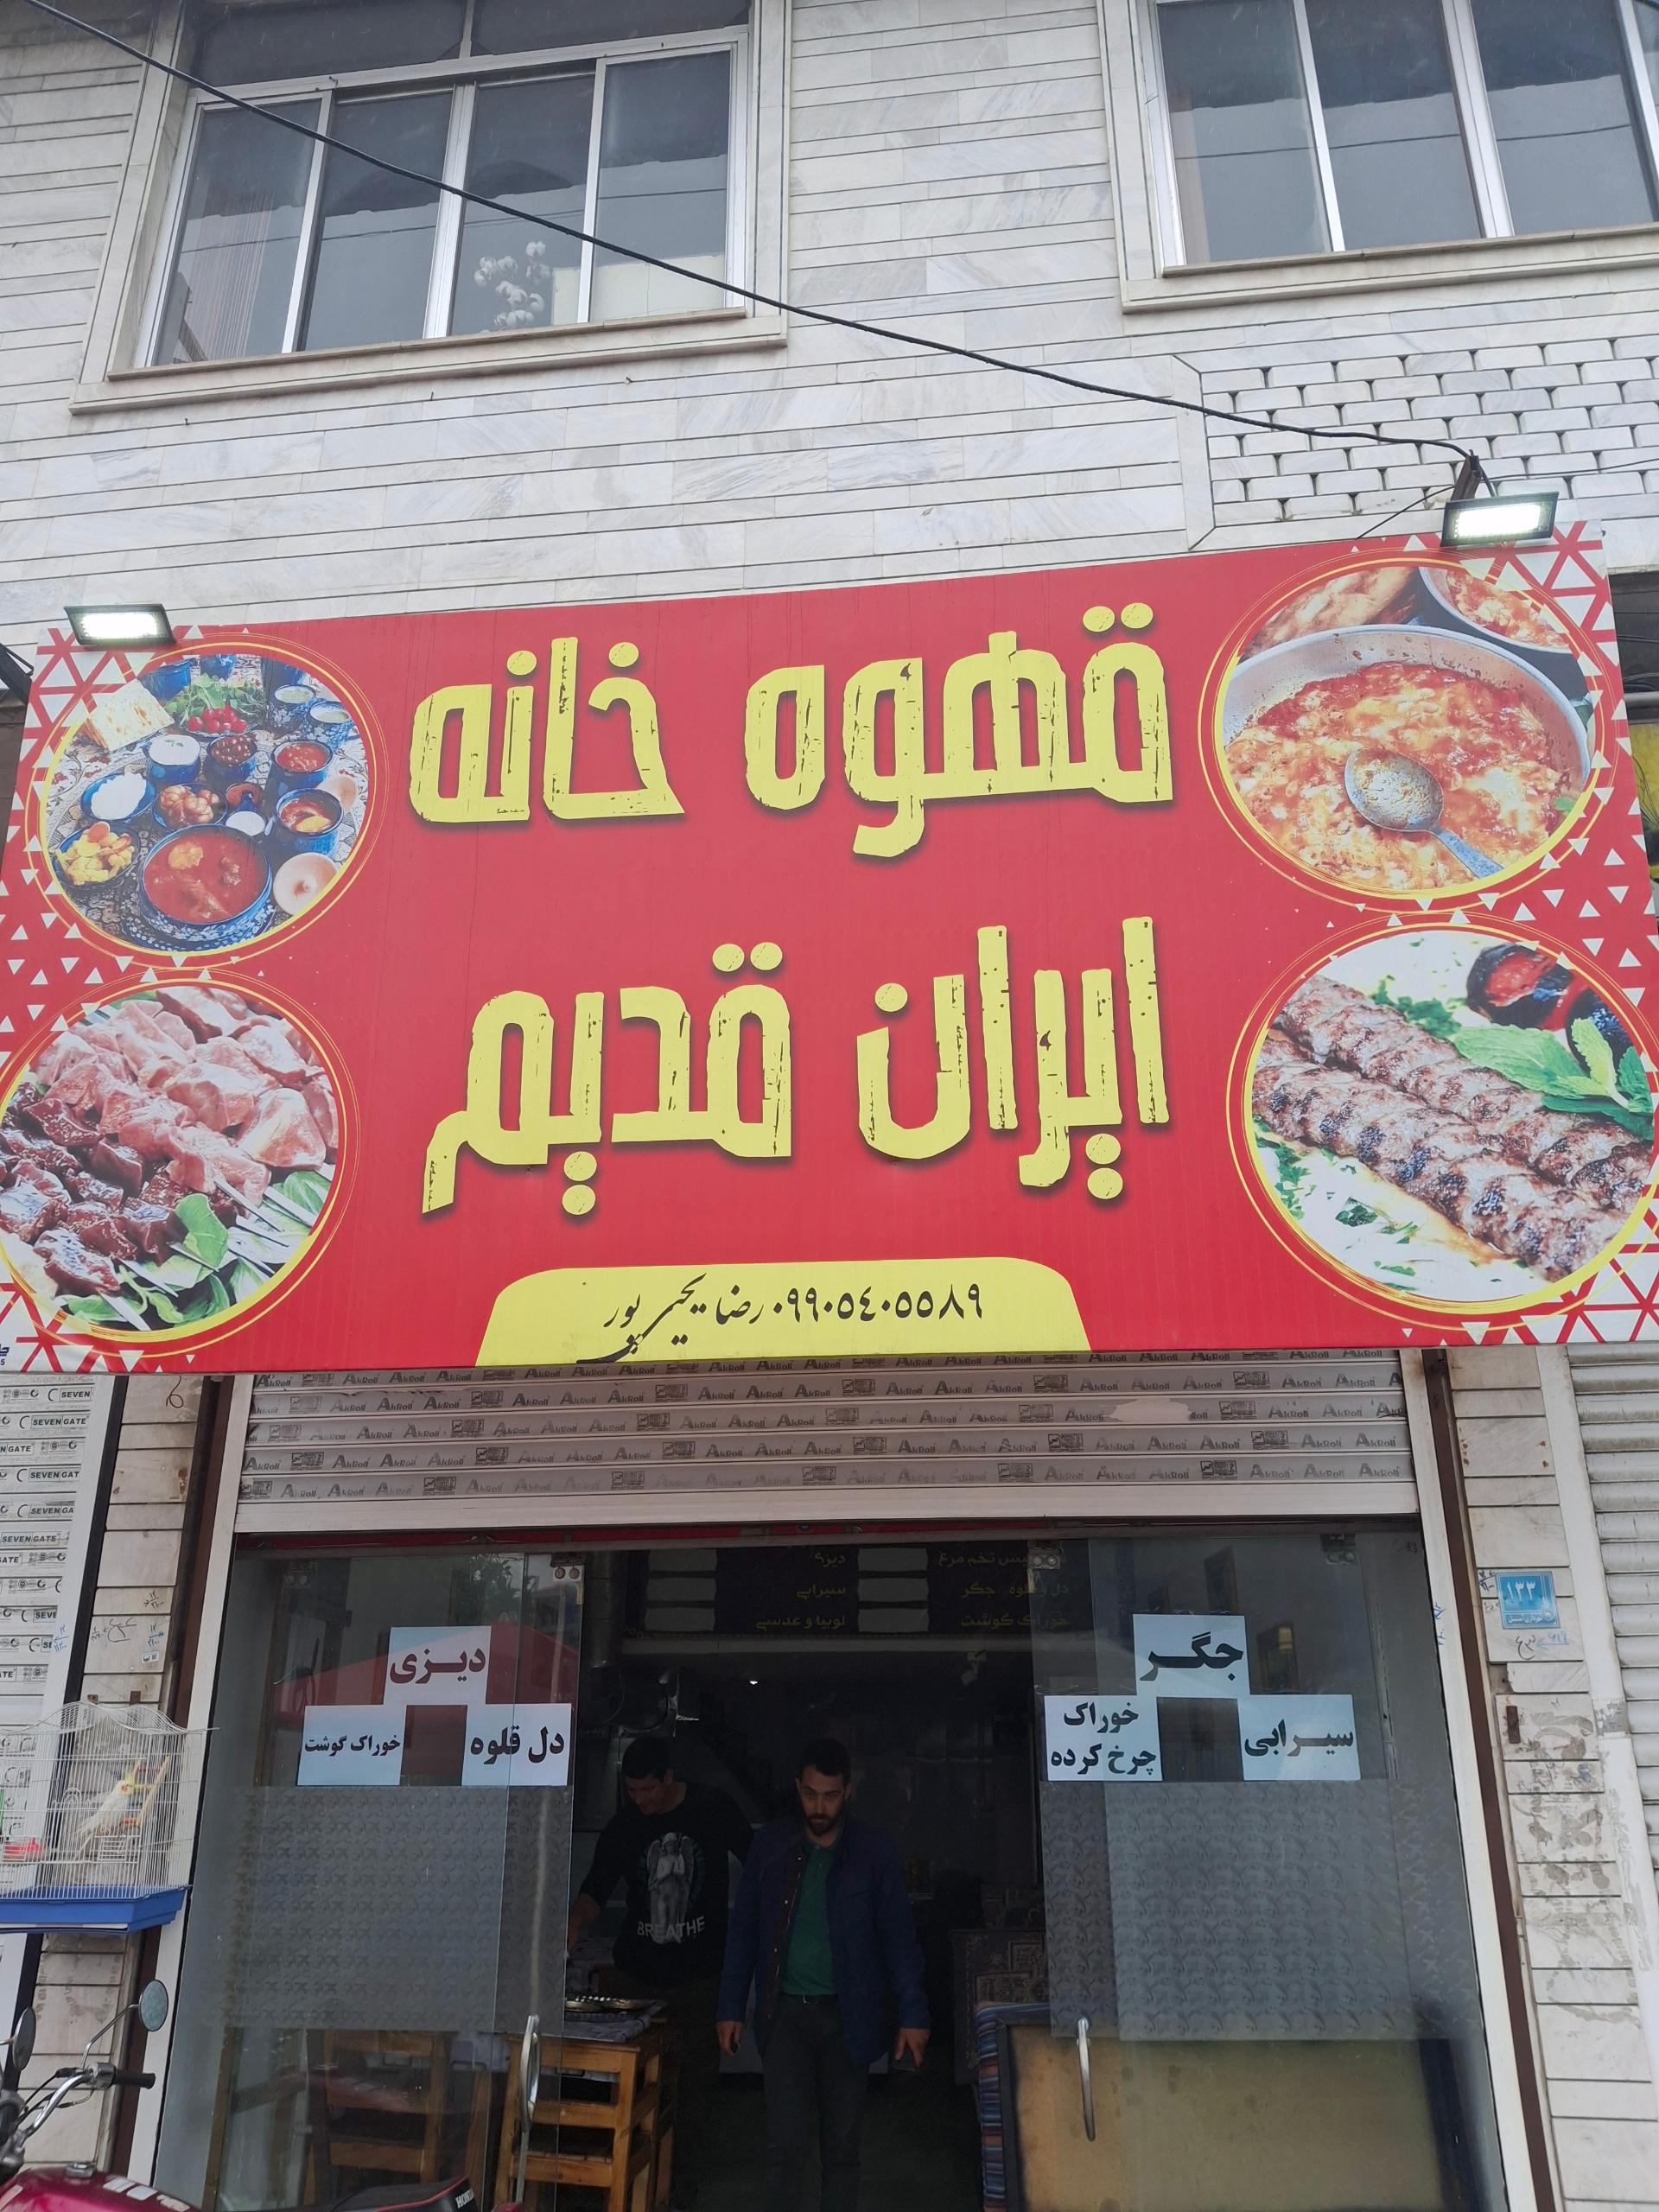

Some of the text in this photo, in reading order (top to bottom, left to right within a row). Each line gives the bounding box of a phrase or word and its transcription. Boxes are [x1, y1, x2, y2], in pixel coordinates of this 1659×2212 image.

[409, 601, 1173, 858] قهوه خانه
[423, 916, 1171, 1215] ایران قدیم
[715, 1285, 764, 1327] رضا
[377, 1397, 412, 1410] AkRoll
[423, 1396, 459, 1409] AkRoll
[512, 1394, 549, 1406] AkRoll
[608, 1389, 643, 1403] AkRoll
[698, 1387, 734, 1401] AkRoll
[747, 1385, 782, 1399] AkRoll
[795, 1384, 830, 1397] AkRoll
[333, 1455, 368, 1468] AkRoll
[899, 1440, 935, 1452] AkRoll
[1200, 1435, 1240, 1449] AkRoll
[1506, 1580, 1535, 1601] ۱۳۳
[389, 1648, 486, 1684] دیزی
[1140, 1631, 1244, 1681] جگر
[1064, 1701, 1140, 1734] خوراک
[304, 1734, 401, 1757] خوراک گوشت
[470, 1725, 565, 1765] دل قلوه
[1244, 1719, 1354, 1757] سیرابی
[1051, 1743, 1157, 1776] چرخ کرده
[637, 1915, 705, 1938] BREATHE
